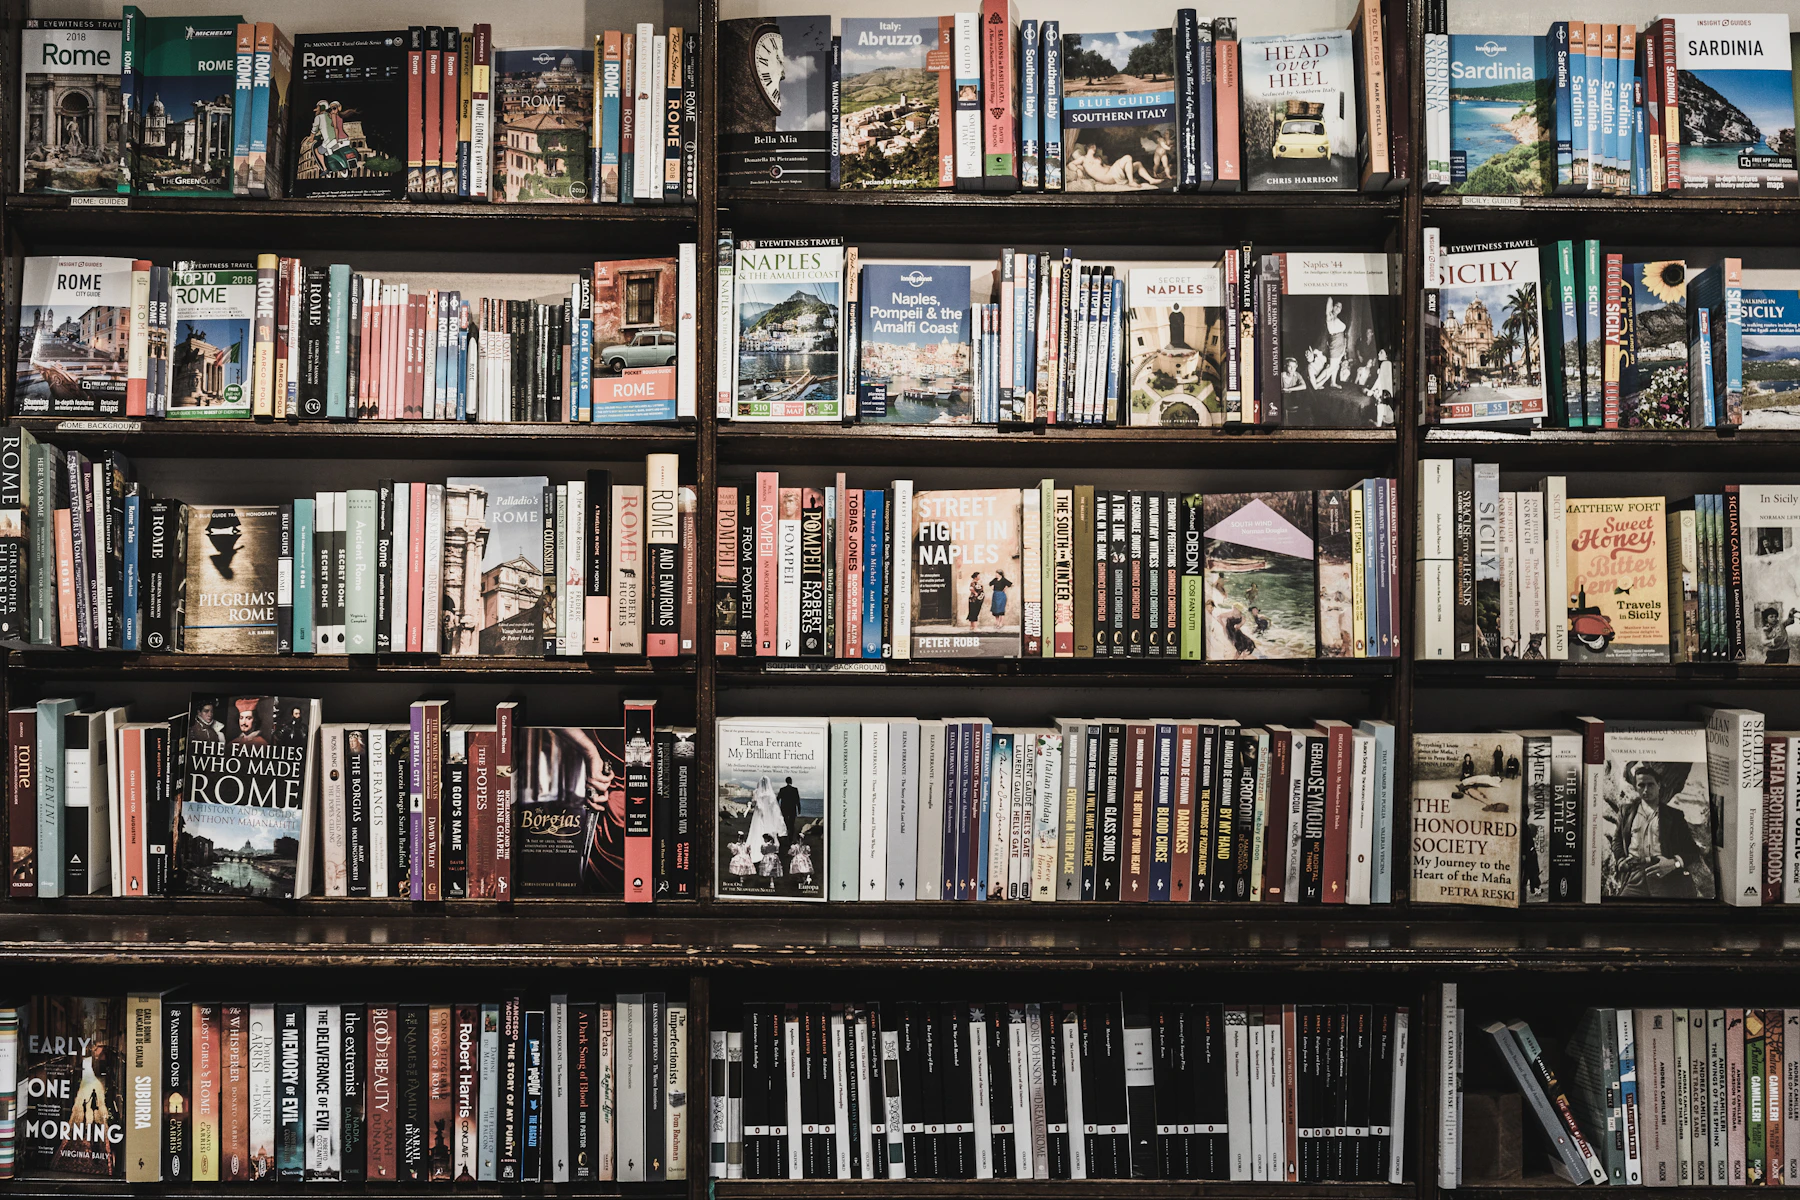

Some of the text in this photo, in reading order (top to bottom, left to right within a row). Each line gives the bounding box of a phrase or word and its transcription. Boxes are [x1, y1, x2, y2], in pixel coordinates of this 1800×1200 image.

[66, 32, 86, 41] 2018
[879, 22, 901, 31] Italy:
[857, 32, 922, 46] Abruzzo
[1688, 41, 1763, 56] SARDINIA
[42, 43, 111, 66] Rome
[303, 52, 354, 67] Rome
[1265, 43, 1329, 61] HEAD
[198, 60, 233, 70] ROME
[236, 54, 251, 89] ROME
[254, 54, 271, 88] ROME
[1276, 58, 1319, 71] over
[1451, 62, 1534, 79] Sardinia
[604, 63, 619, 98] ROME
[1268, 72, 1329, 88] HEEL
[1667, 66, 1675, 104] SARDINIA
[521, 96, 565, 107] ROME
[686, 91, 695, 122] ROME
[1078, 94, 1161, 108] BLUE GUIDE
[1573, 75, 1584, 128] Sardinia
[1604, 81, 1615, 134] Sardinia
[1619, 82, 1631, 137] Sardinia
[668, 100, 679, 147] ROME
[1072, 109, 1167, 123] SOUTHERN ITALY
[754, 135, 798, 144] Bella Mia
[1267, 175, 1338, 184] CHRIS HARRISON
[1451, 240, 1534, 252] EYEWITNESS TRAVEL
[740, 253, 821, 271] NAPLES
[1303, 261, 1328, 269] Naples
[57, 274, 101, 290] ROME
[232, 275, 252, 284] 2018
[808, 270, 840, 278] COAST
[176, 287, 226, 303] ROME
[257, 278, 273, 318] ROME
[581, 278, 589, 310] MOON
[892, 292, 940, 306] Naples,
[1147, 284, 1203, 295] NAPLES
[310, 282, 320, 325] ROME
[1564, 285, 1573, 317] SICILY
[1727, 289, 1741, 326] SICILY
[870, 307, 962, 321] Pompeii & the
[1606, 303, 1619, 344] SICILY
[874, 321, 958, 334] Amalfi Coast
[613, 382, 655, 397] ROME
[2, 436, 19, 504] ROME
[918, 496, 997, 518] STREET
[1565, 503, 1661, 513] MATTHEW FORT
[1760, 493, 1798, 505] In Sicily
[492, 511, 538, 523] ROME
[651, 491, 674, 539] ROME
[1603, 516, 1653, 534] Sweet
[152, 515, 164, 558] ROME
[621, 495, 638, 563] ROME
[761, 505, 773, 557] POMPEII
[849, 494, 857, 571] TOBIAS JONES
[919, 521, 1007, 541] FIGHT IN
[1479, 502, 1497, 570] SICILY
[803, 512, 821, 574] POMPEII
[1729, 496, 1740, 586] SICILIAN CAROUSEL
[784, 525, 794, 585] POMPEII
[919, 544, 997, 565] NAPLES
[1186, 531, 1198, 574] DIBDIN
[742, 526, 752, 619] FROM POMPEII
[1587, 555, 1656, 576] Bitter
[659, 548, 673, 626] AND ENVIRONS
[229, 608, 274, 621] ROME
[619, 582, 627, 626] HUGHES
[802, 581, 812, 633] HARRIS
[812, 581, 822, 633] ROBERT
[1617, 601, 1661, 610] Travels
[1628, 610, 1661, 622] Sicily
[919, 637, 980, 648] PETER ROBB
[191, 741, 303, 760] THE FAMILIES
[740, 737, 802, 747] Elena Ferrante
[728, 748, 814, 761] My Brilliant Friend
[19, 746, 30, 788] rome
[192, 756, 300, 778] WHO MADE
[351, 754, 361, 822] THE BORGIAS
[372, 734, 383, 826] POPE FRANCIS
[190, 773, 301, 810] ROME
[1305, 777, 1324, 838] SEYMOUR
[1413, 798, 1450, 813] THE
[1768, 743, 1786, 885] MAFIA BROTHERHOODS
[521, 810, 581, 836] Borgias
[1176, 809, 1190, 854] DARKNESS
[1413, 818, 1517, 837] HONOURED
[1155, 807, 1169, 862] BLOOD CURSE
[1413, 838, 1488, 855] SOCIETY
[1413, 856, 1431, 868] My
[1434, 857, 1477, 871] Journey
[1494, 860, 1510, 870] the
[1413, 869, 1511, 884] Heart of the Mafia
[1440, 887, 1515, 900] PETRA RESKI
[285, 1013, 295, 1027] THE
[29, 1036, 90, 1056] EARLY
[282, 1029, 298, 1083] MEMORY
[460, 1023, 472, 1118] Robert Harris
[28, 1079, 70, 1099] ONE
[1751, 1076, 1761, 1122] CAMILLERI
[1769, 1076, 1779, 1121] CAMILLERI
[135, 1076, 151, 1130] SUBURRA
[282, 1098, 298, 1126] EVIL
[26, 1120, 123, 1143] MORNING
